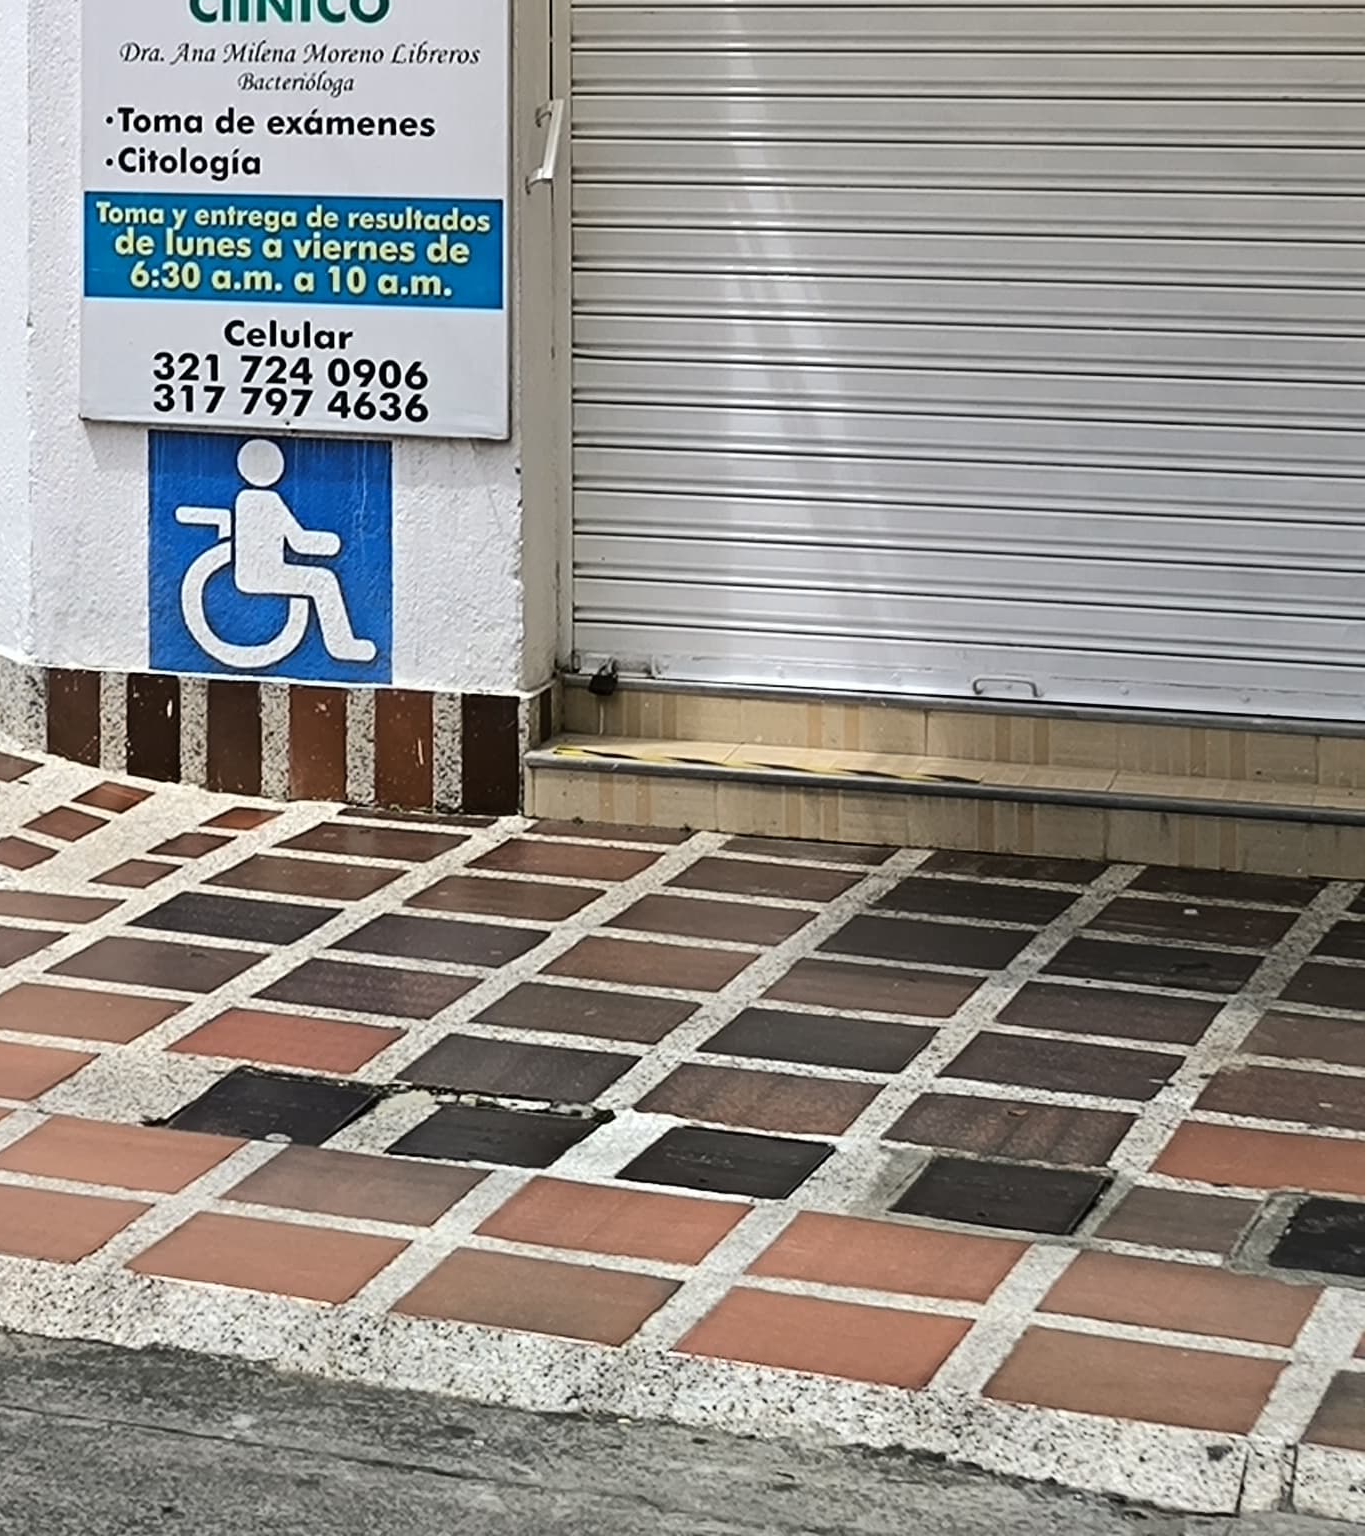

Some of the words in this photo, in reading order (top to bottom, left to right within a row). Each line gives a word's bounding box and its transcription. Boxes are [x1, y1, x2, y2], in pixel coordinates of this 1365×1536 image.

[119, 42, 166, 65] Dra.
[169, 42, 216, 65] Ana
[223, 40, 296, 65] Milena
[303, 42, 385, 65] Moreno
[390, 40, 480, 65] Libreros
[237, 71, 355, 98] Bacterióloga
[118, 107, 204, 135] Toma
[215, 107, 256, 135] de
[267, 109, 436, 137] exámenes
[117, 147, 262, 181] Citología
[96, 201, 164, 226] Toma
[172, 209, 187, 232] y
[194, 205, 298, 232] entrega
[306, 205, 339, 230] de
[348, 208, 491, 232] resultados
[114, 227, 155, 256] de
[166, 228, 252, 259] lunes
[262, 239, 283, 260] a
[293, 234, 415, 263] viernes
[426, 234, 470, 264] de
[129, 261, 201, 290] 6:30
[211, 271, 283, 293] a.m.
[293, 271, 315, 294] a
[328, 265, 366, 295] 10
[377, 274, 453, 298] a.m.
[223, 321, 354, 350] Celular
[153, 352, 221, 382] 321
[240, 355, 313, 386] 724
[327, 359, 429, 390] 0906
[153, 384, 226, 414] 317
[240, 387, 314, 417] 797
[327, 391, 429, 423] 4636
